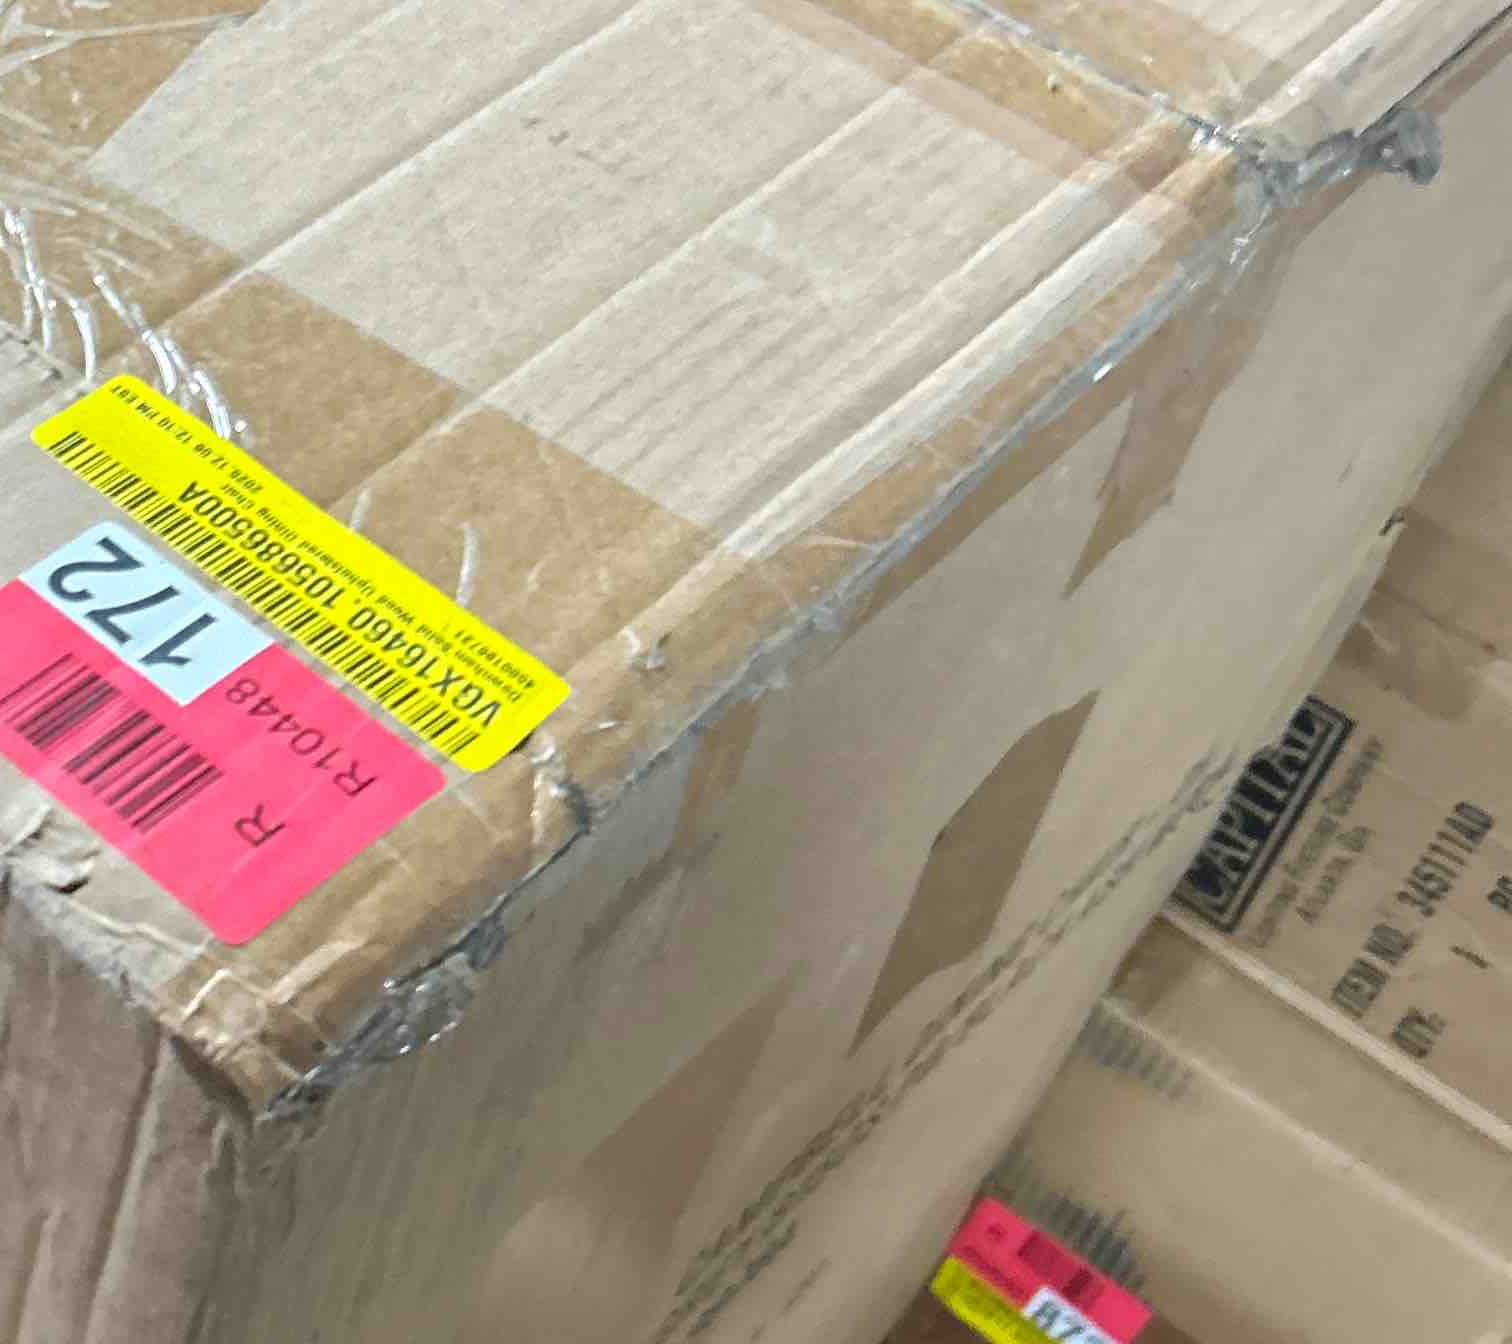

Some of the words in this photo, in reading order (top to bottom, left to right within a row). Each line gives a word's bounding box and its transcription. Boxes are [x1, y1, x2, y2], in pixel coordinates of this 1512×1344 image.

[47, 534, 217, 668] 172
[173, 478, 348, 609] 105686500A
[224, 675, 378, 800] R10448
[233, 803, 287, 848] R
